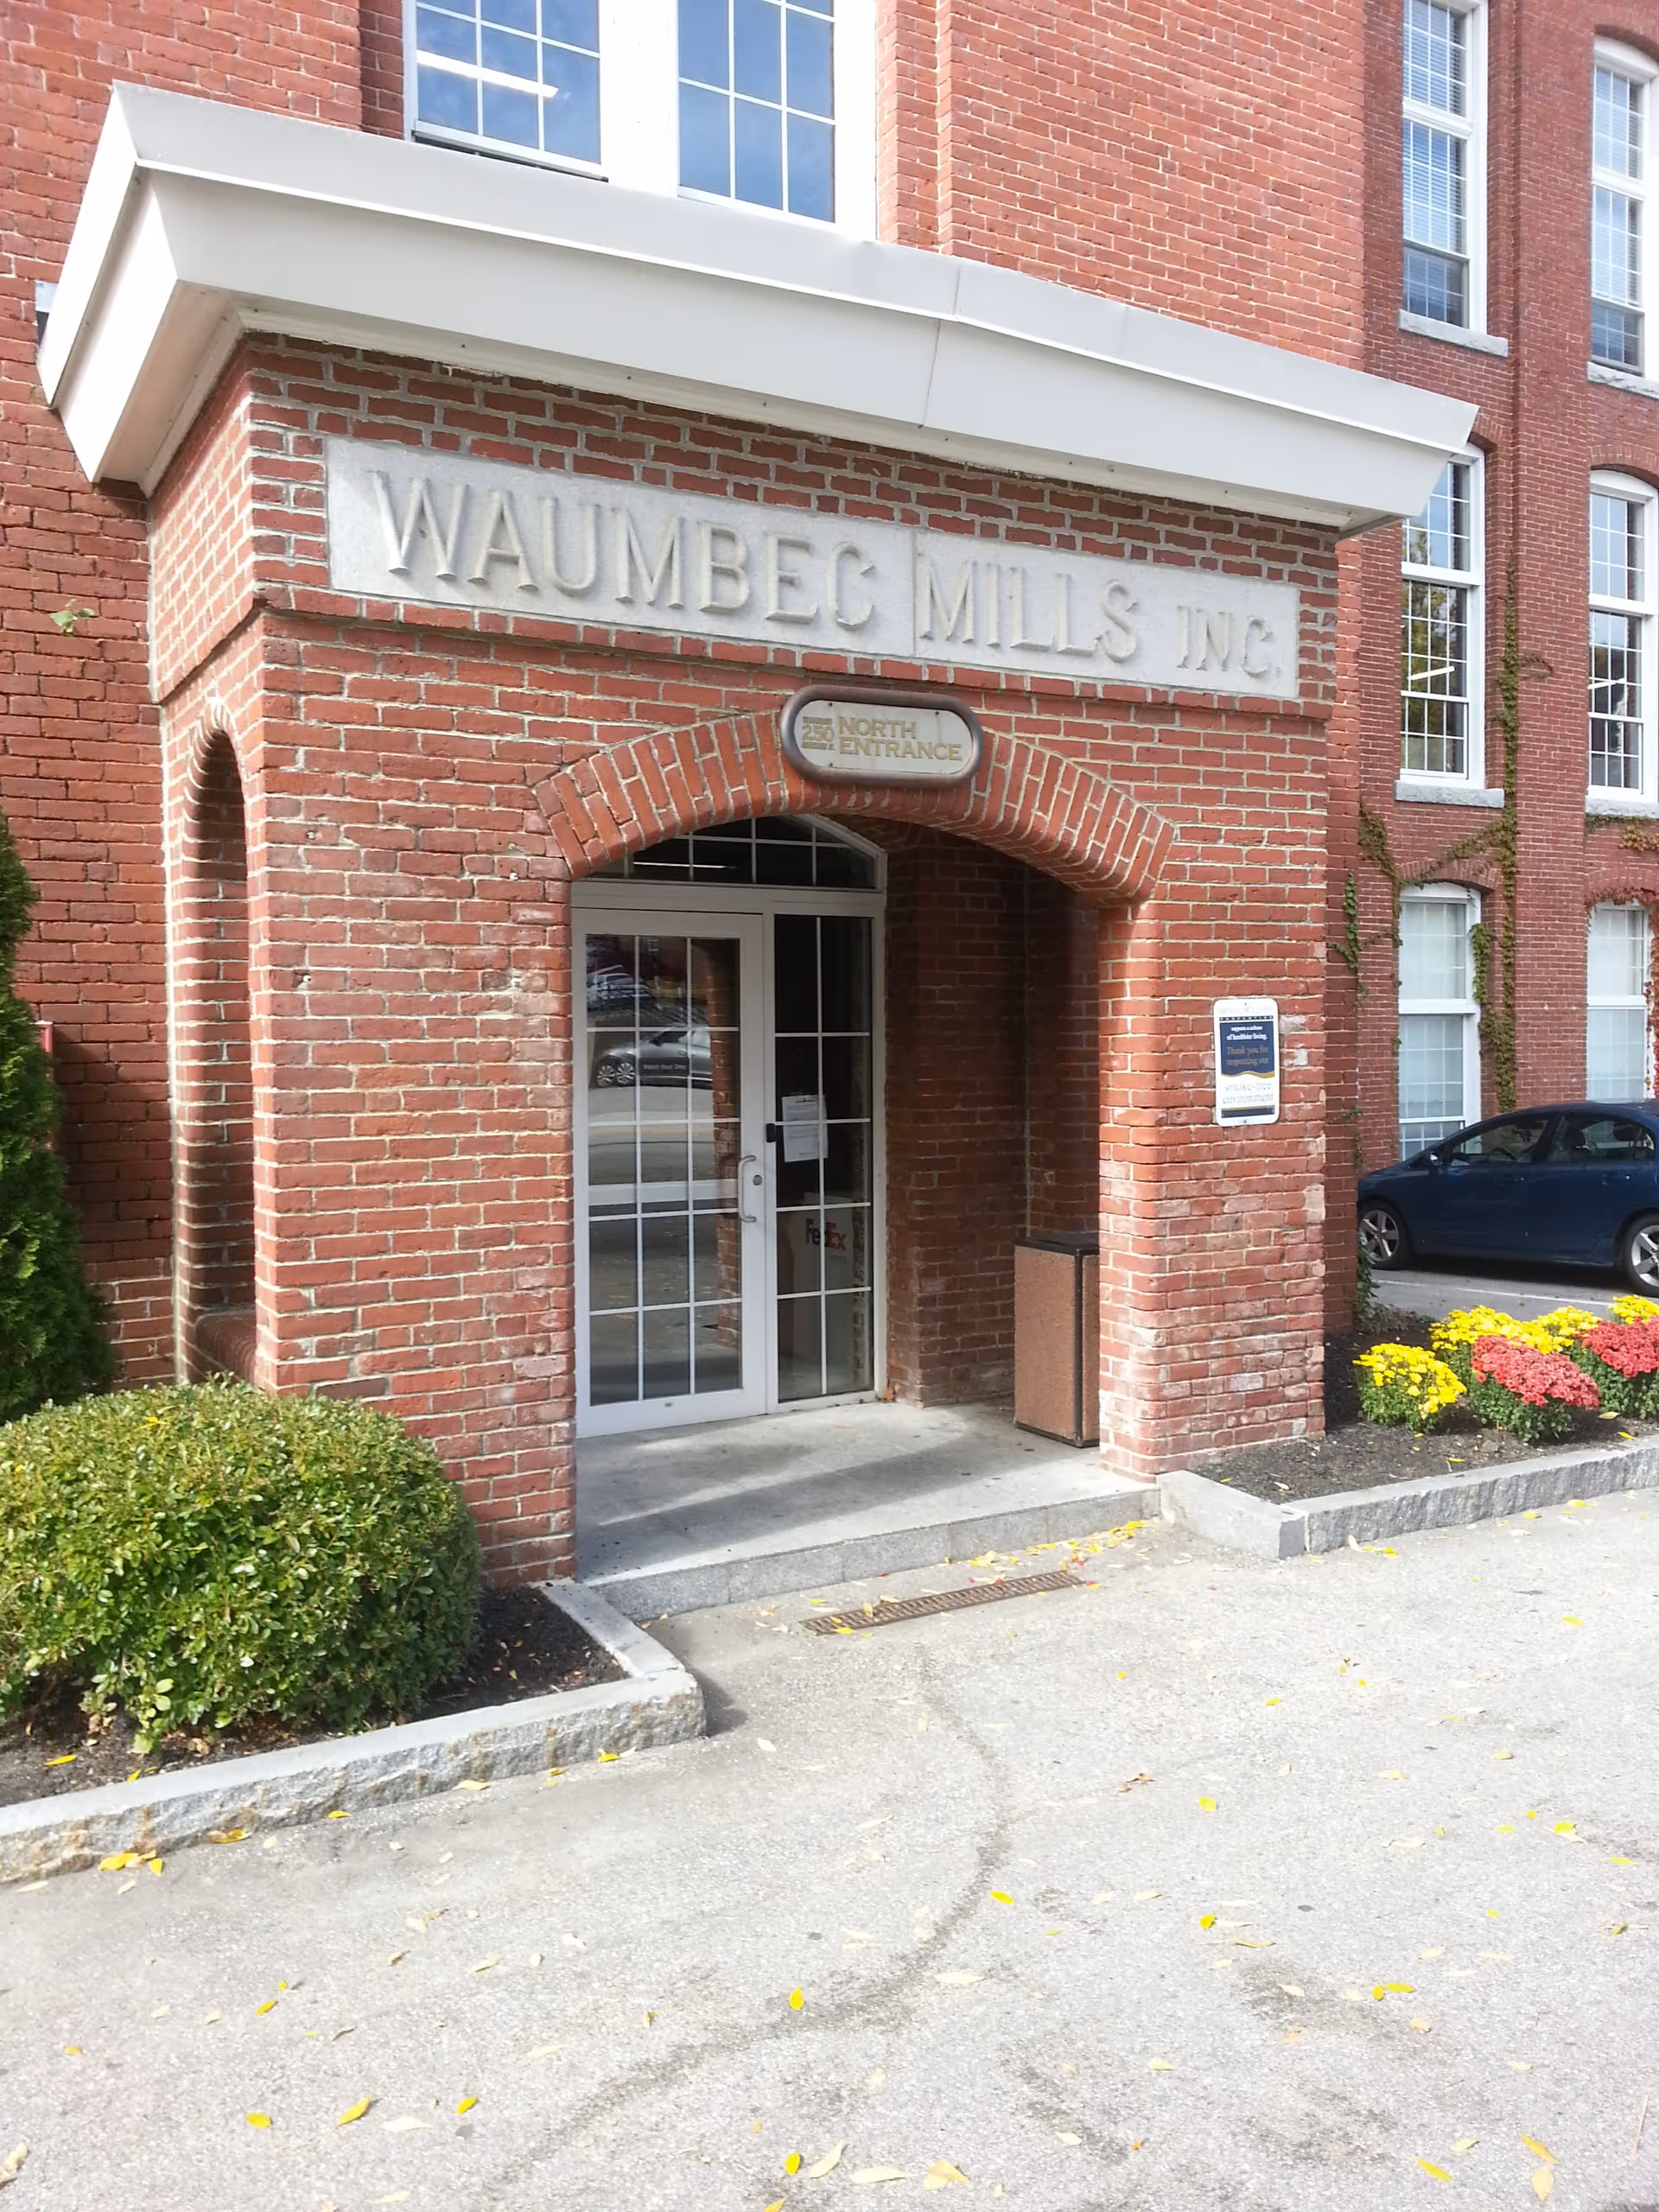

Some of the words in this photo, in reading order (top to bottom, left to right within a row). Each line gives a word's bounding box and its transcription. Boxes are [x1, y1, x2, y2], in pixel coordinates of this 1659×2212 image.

[369, 469, 875, 632] WAUMBEC
[916, 553, 1140, 664] MILLS
[801, 724, 835, 743] 250
[838, 716, 917, 740] NORTH
[839, 737, 963, 761] ENTRANCE
[1227, 1046, 1245, 1055] Thank
[1246, 1047, 1259, 1057] you
[1259, 1044, 1268, 1053] for
